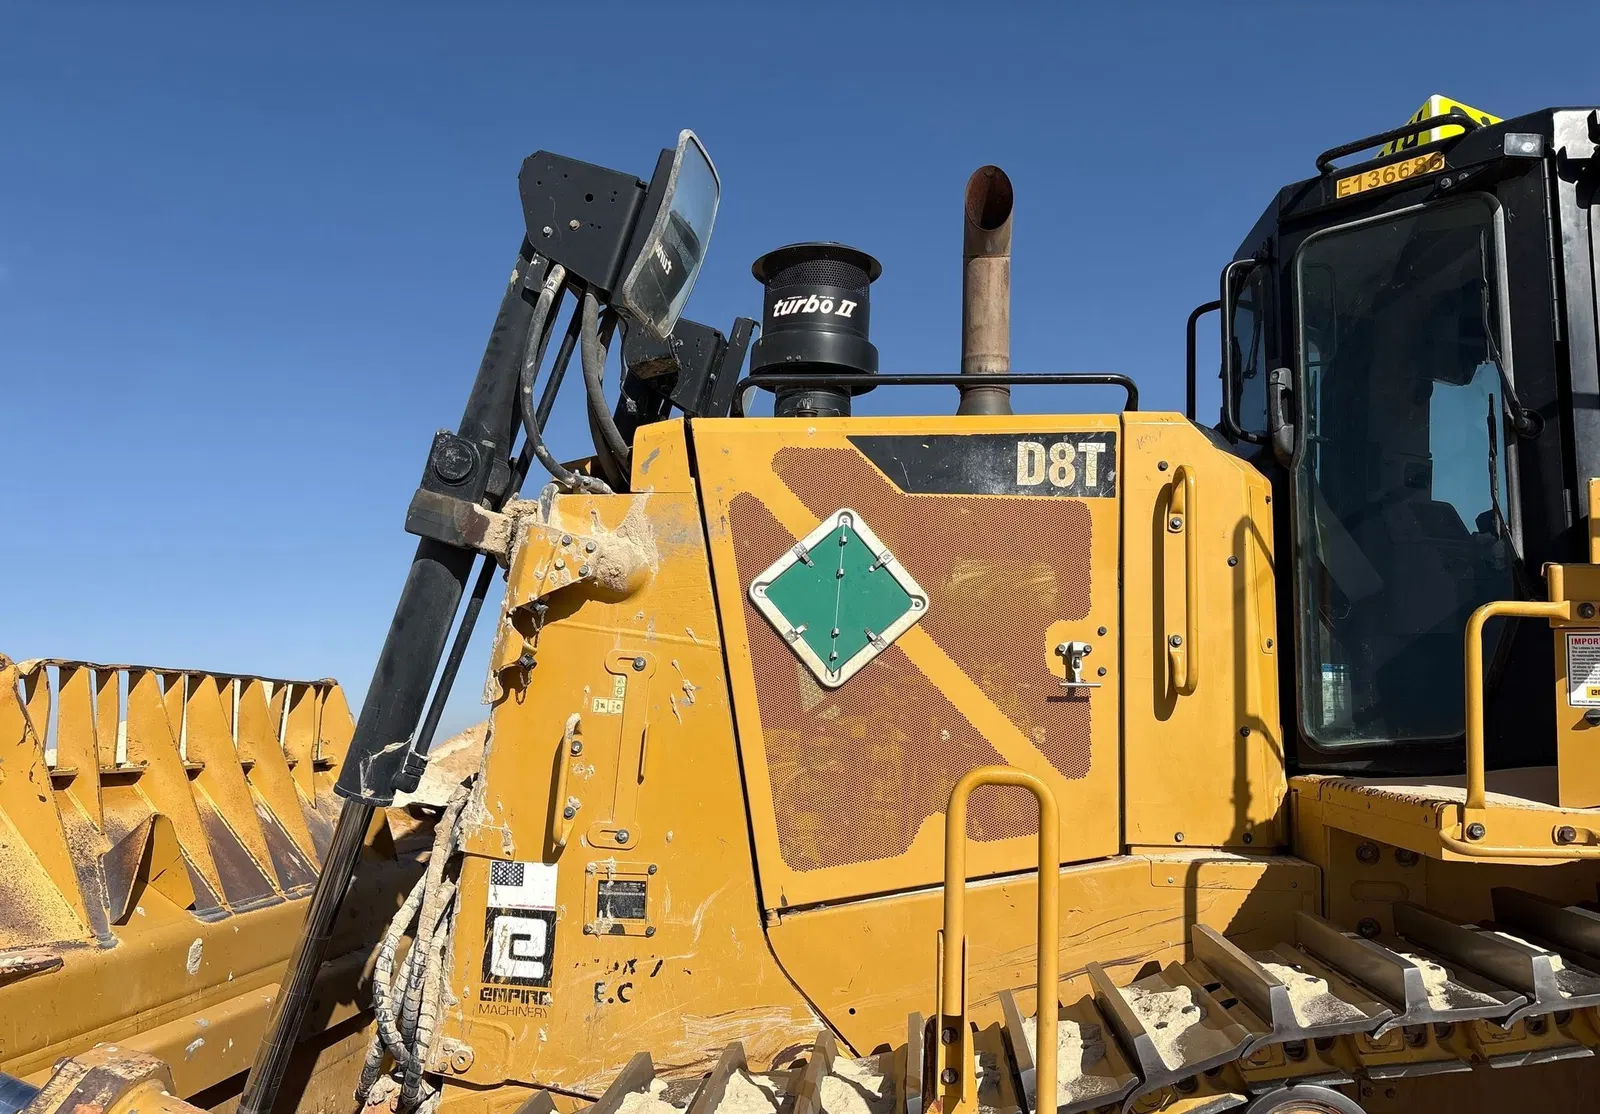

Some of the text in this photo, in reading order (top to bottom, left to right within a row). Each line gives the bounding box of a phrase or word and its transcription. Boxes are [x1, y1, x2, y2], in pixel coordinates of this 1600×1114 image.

[772, 294, 834, 318] turbo
[1017, 441, 1106, 488] D8T
[1571, 637, 1600, 645] IMPOR
[478, 1003, 549, 1019] MACHINERY
